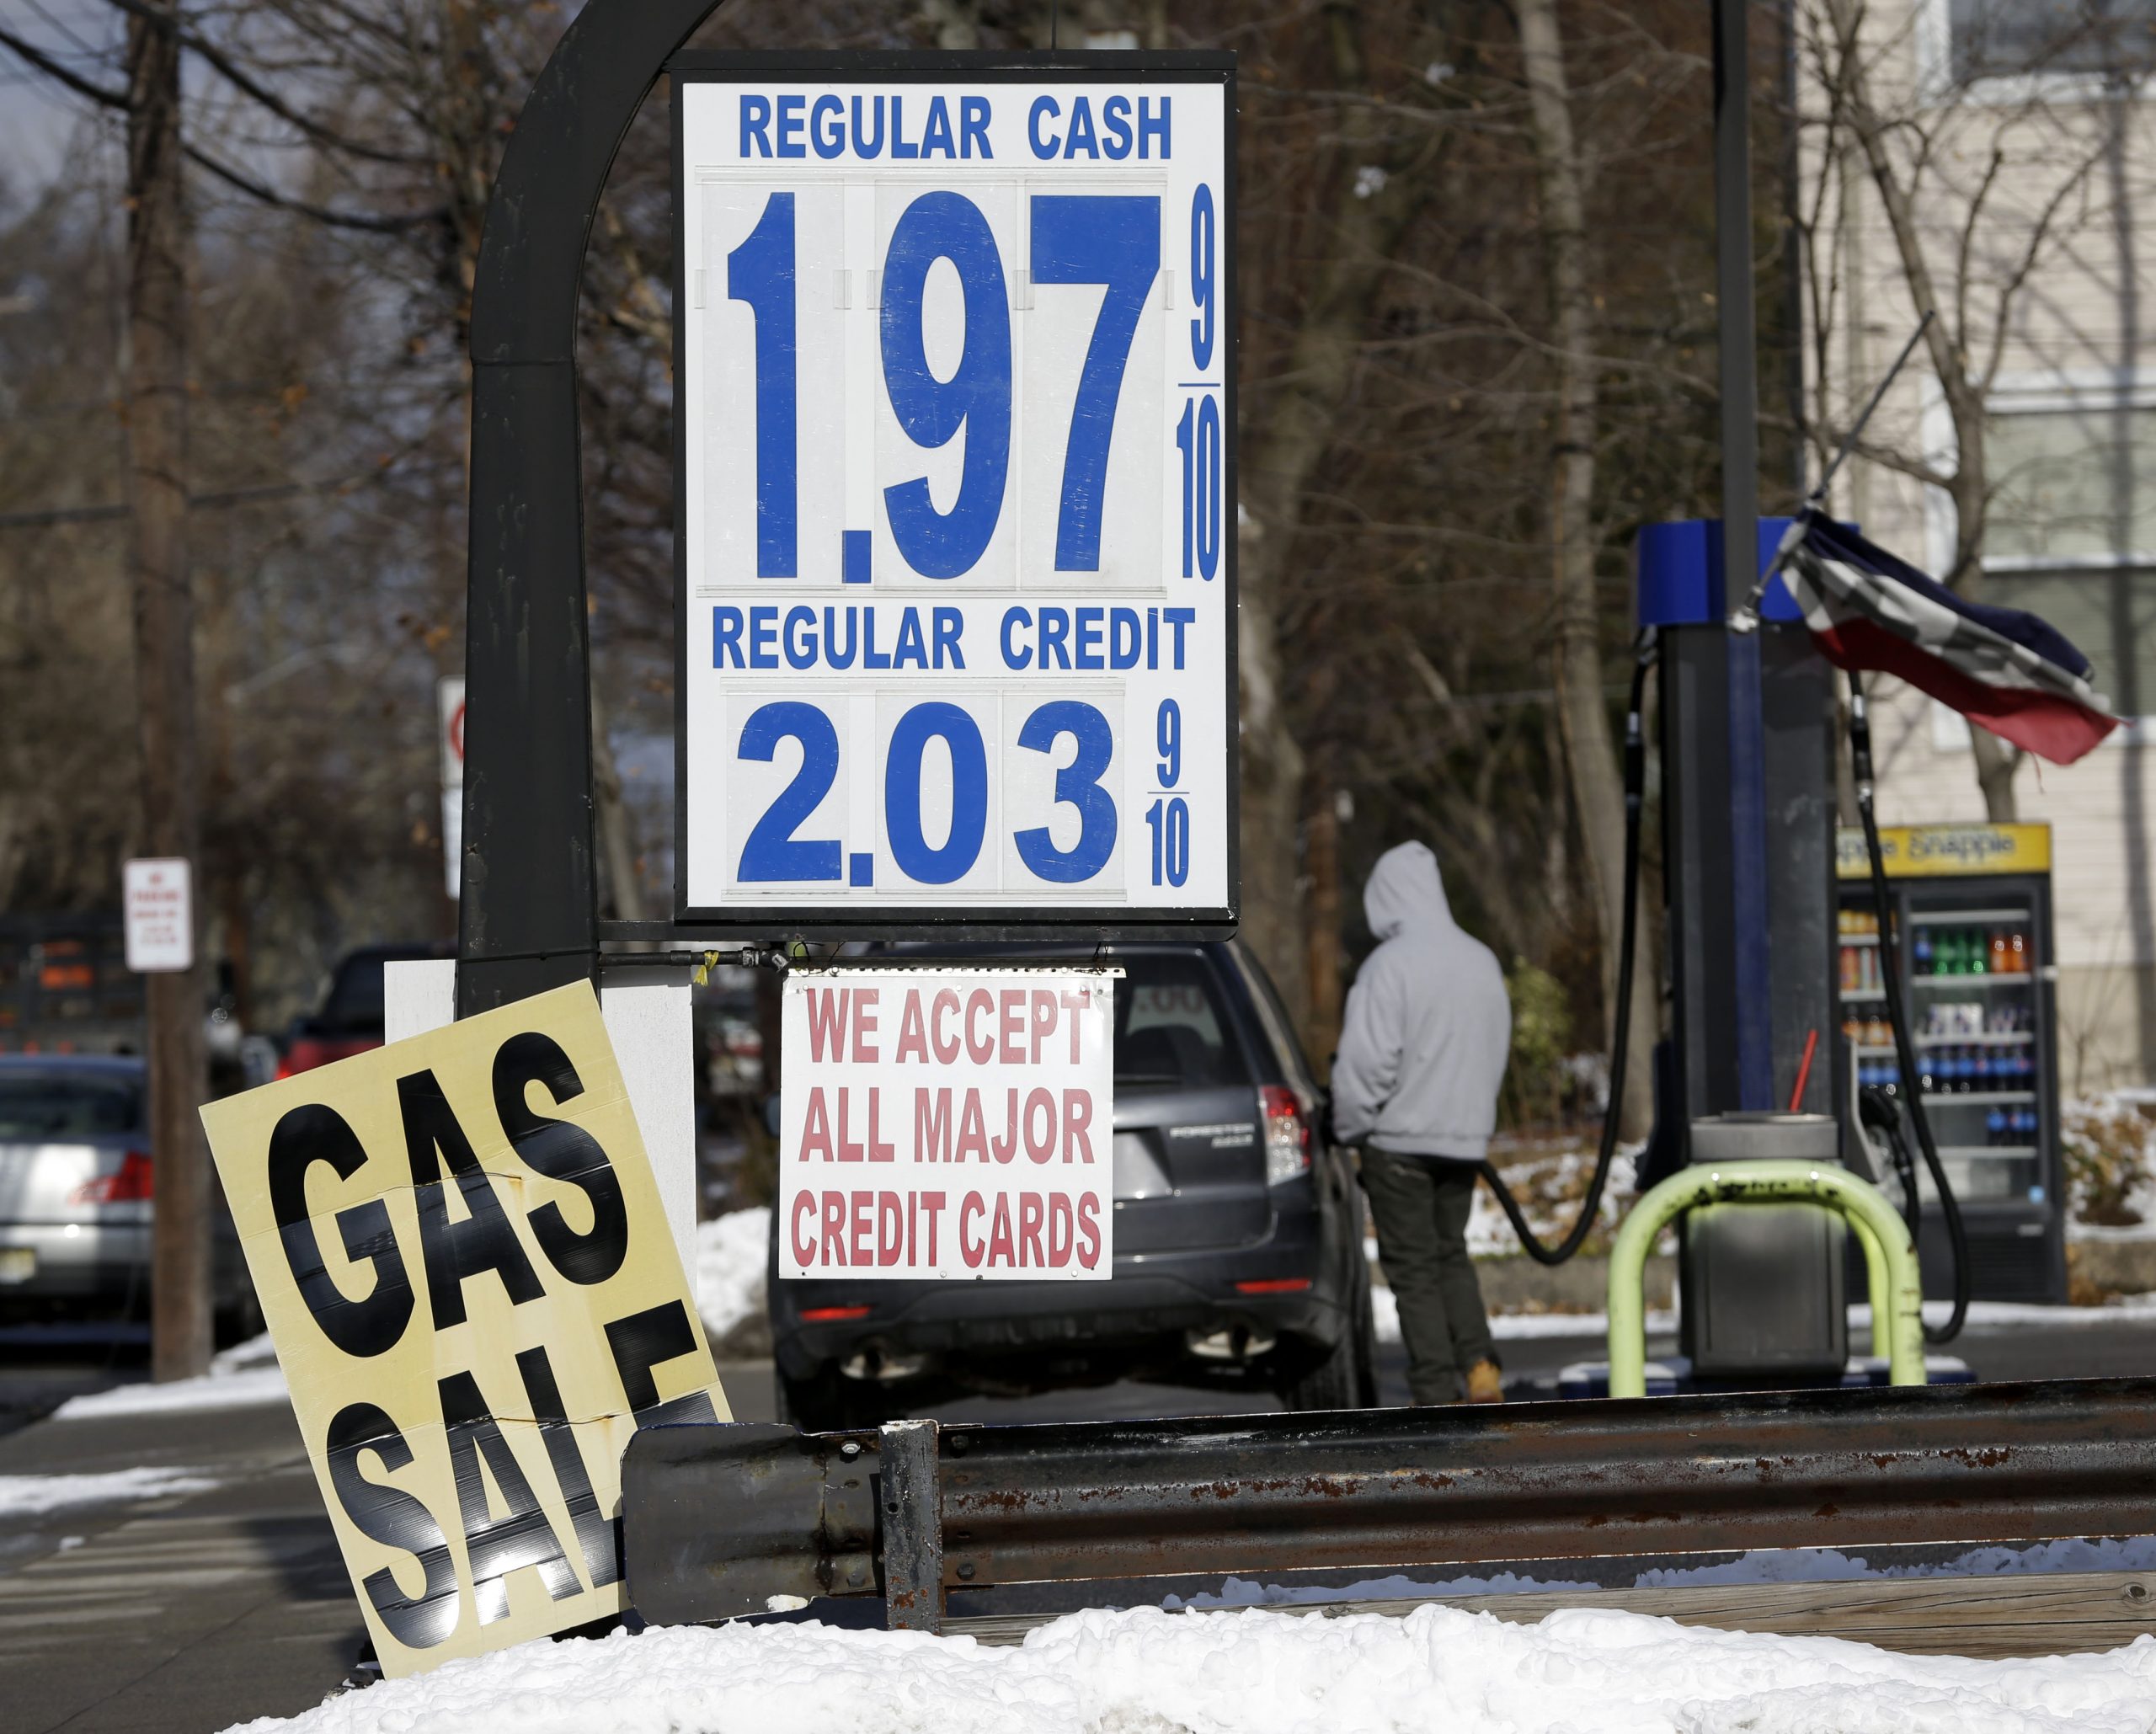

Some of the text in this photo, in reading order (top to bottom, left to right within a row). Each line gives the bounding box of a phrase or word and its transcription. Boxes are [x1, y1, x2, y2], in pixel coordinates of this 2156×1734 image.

[739, 94, 1171, 160] REGULAR CASH
[728, 190, 1161, 584] 1.97
[712, 606, 1195, 670] REGULAR CREDIT
[737, 701, 1118, 887] 2.03
[806, 988, 1091, 1064] WE ACCEPT
[798, 1086, 1095, 1164] ALL MAJOR
[268, 1031, 628, 1358] GAS
[791, 1189, 1102, 1269] CREDIT CARDS
